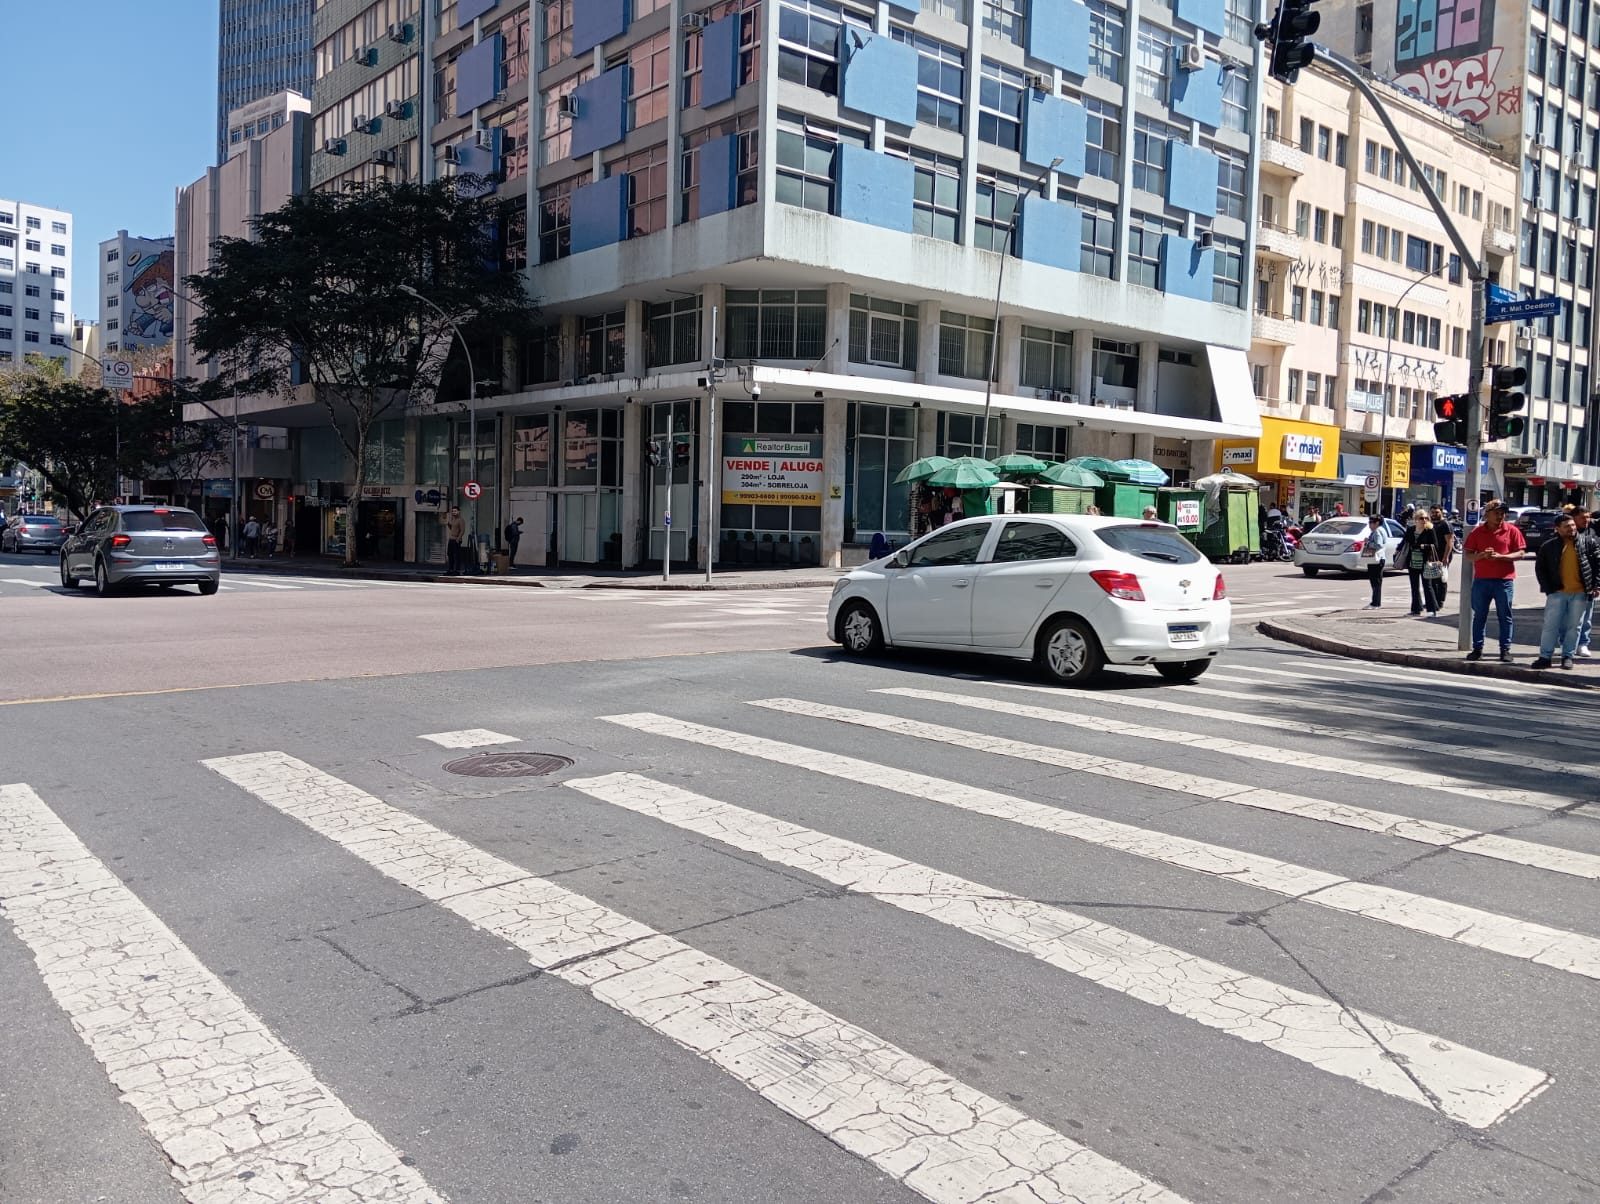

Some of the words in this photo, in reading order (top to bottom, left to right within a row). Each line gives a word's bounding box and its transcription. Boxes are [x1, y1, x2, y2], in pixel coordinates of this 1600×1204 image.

[1525, 302, 1555, 311] Deodoro
[756, 442, 809, 452] RealtorBrasil
[1299, 440, 1322, 456] maxi
[1232, 449, 1253, 459] maxi
[1445, 452, 1465, 466] ÓTICA
[726, 460, 770, 471] VENDE
[780, 462, 824, 472] ALUGA
